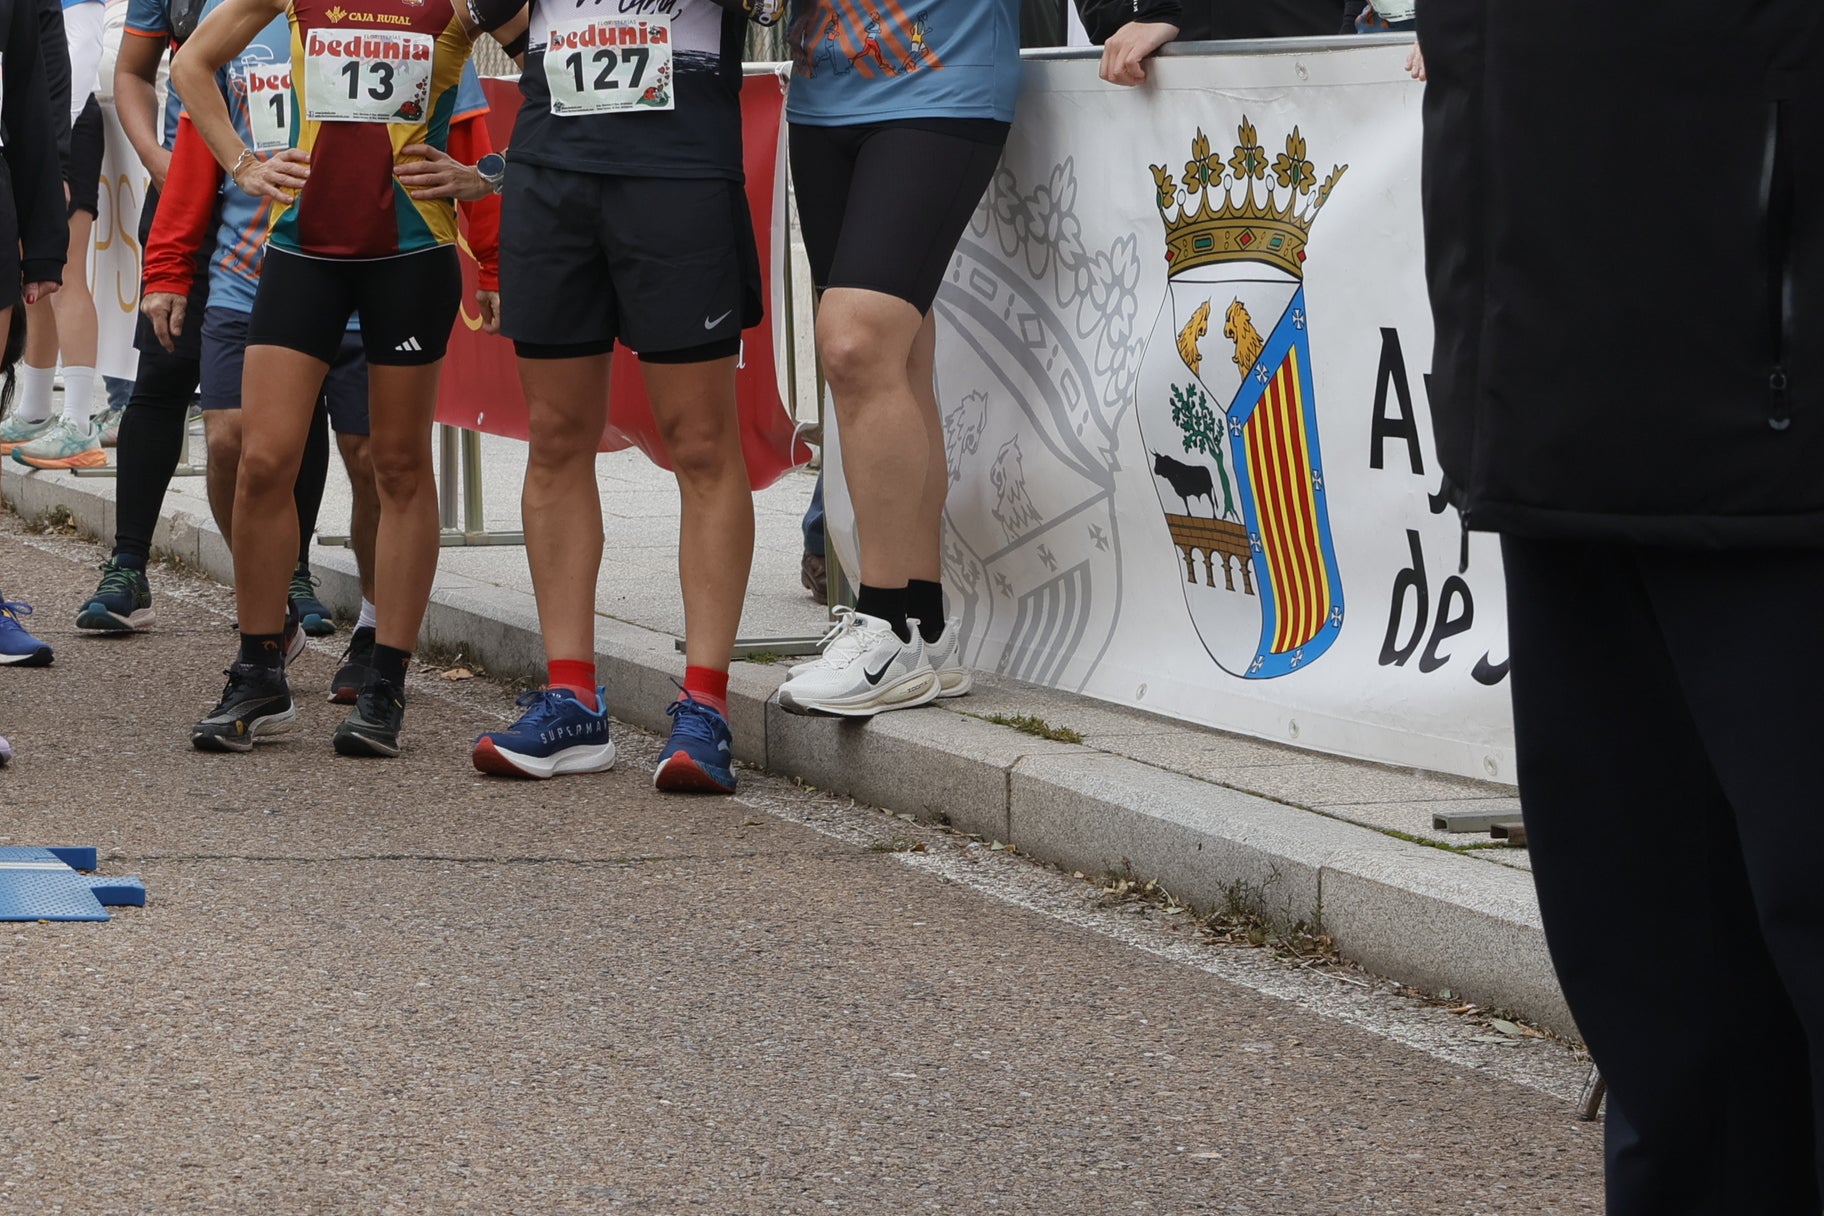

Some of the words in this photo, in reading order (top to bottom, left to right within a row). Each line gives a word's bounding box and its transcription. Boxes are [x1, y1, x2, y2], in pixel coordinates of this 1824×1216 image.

[348, 12, 375, 22] CAJA
[377, 14, 412, 26] RURAL
[549, 21, 668, 52] bedunia
[308, 35, 430, 61] bedunia
[341, 61, 394, 101] 13
[566, 48, 650, 92] 127
[1378, 528, 1474, 673] de
